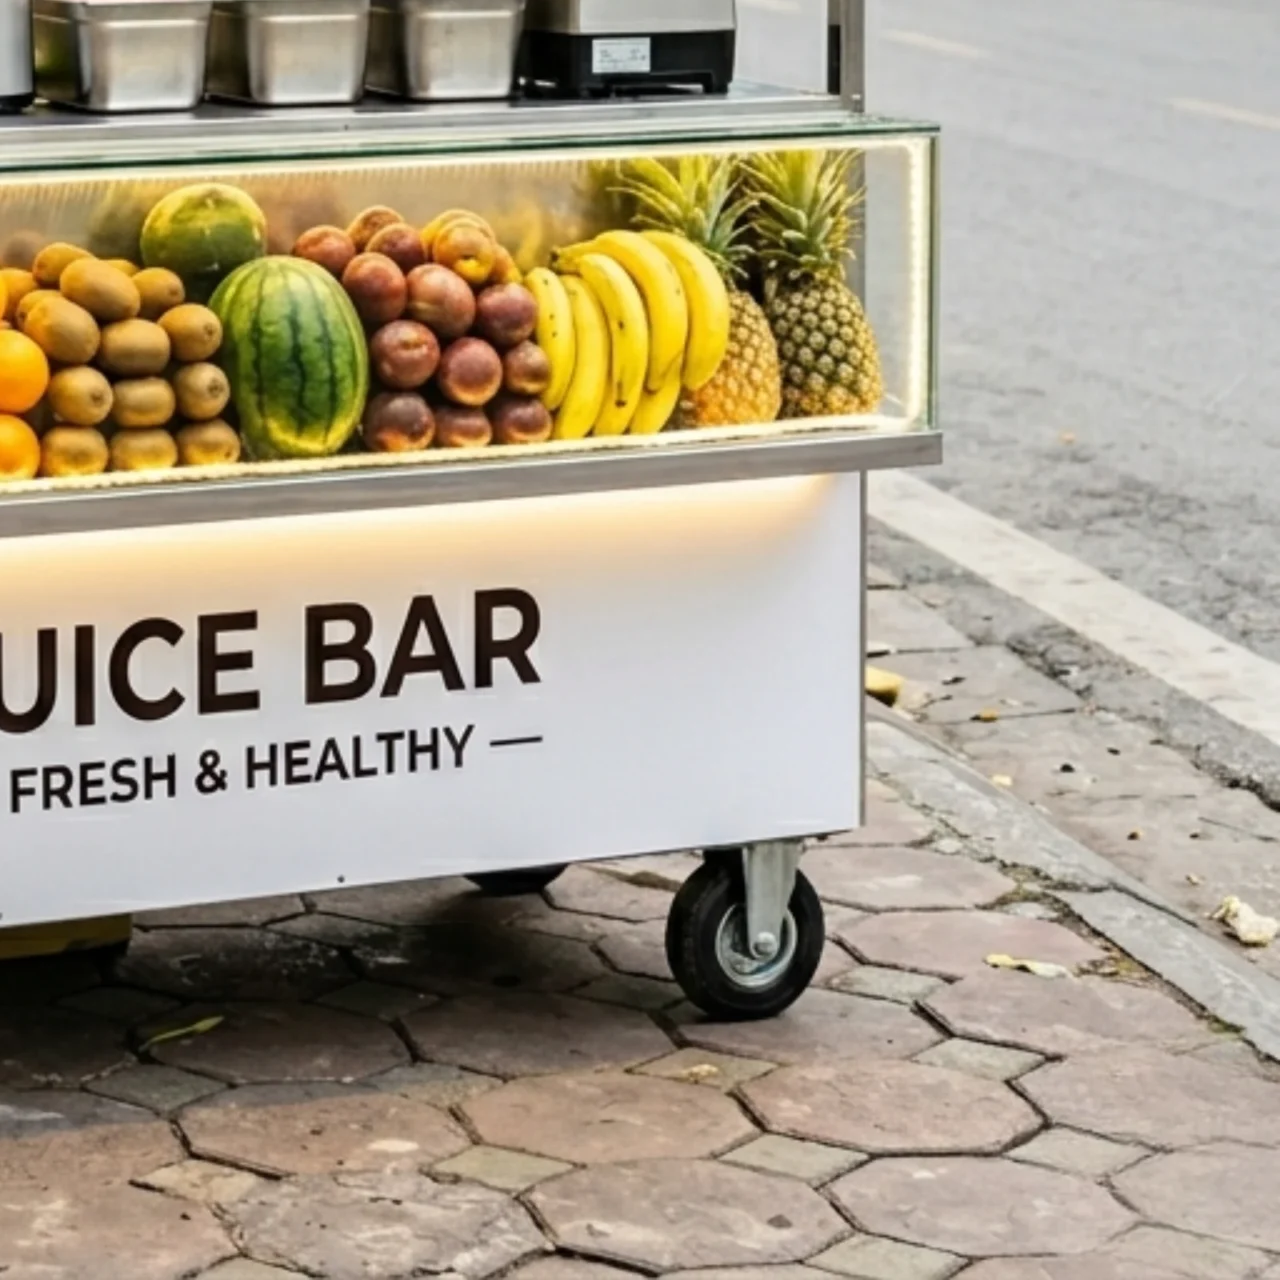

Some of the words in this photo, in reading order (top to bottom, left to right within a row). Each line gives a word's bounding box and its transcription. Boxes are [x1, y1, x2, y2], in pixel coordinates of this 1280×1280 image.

[305, 586, 542, 706] BAR
[9, 753, 177, 814] FRESH
[195, 749, 228, 794] &
[245, 724, 475, 789] HEALTHY
